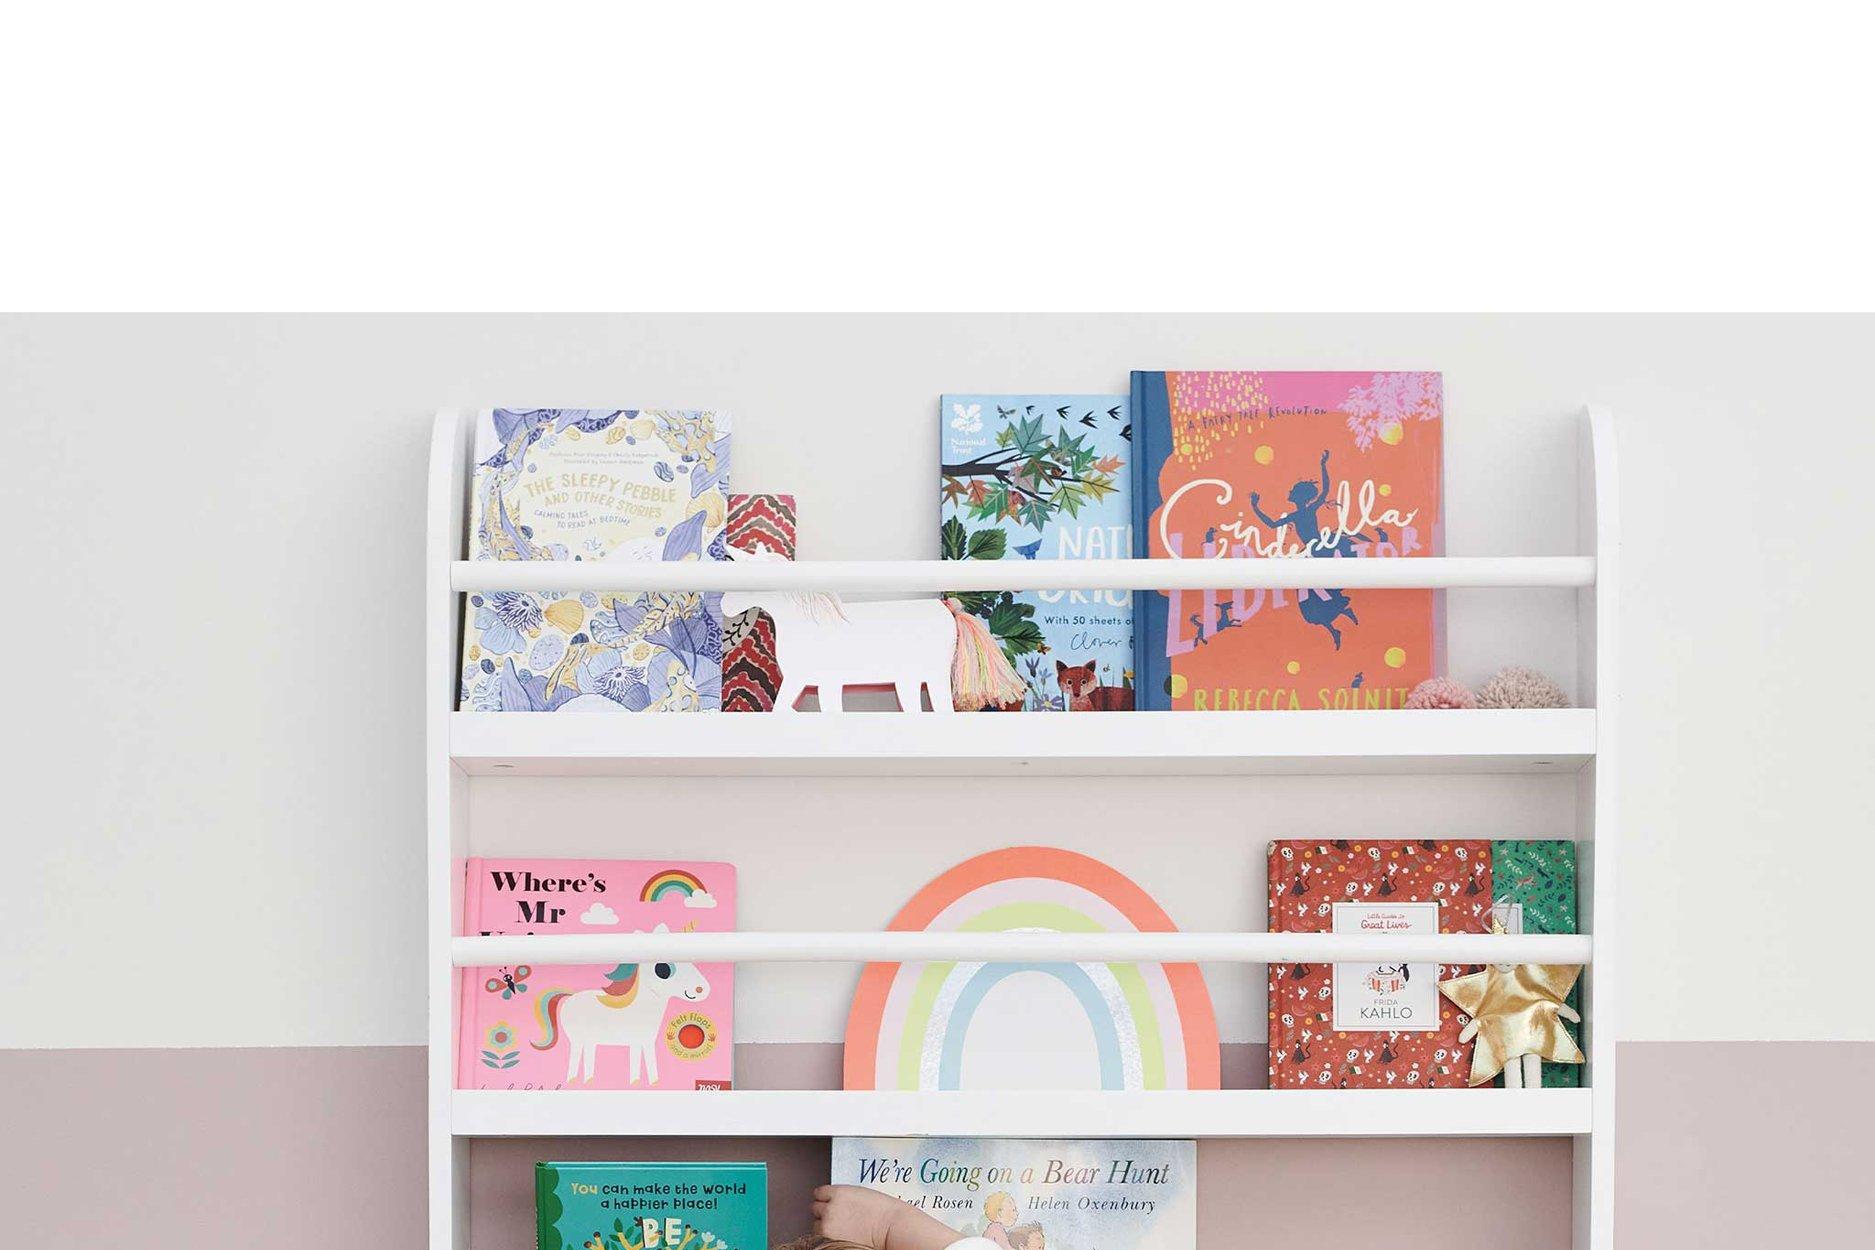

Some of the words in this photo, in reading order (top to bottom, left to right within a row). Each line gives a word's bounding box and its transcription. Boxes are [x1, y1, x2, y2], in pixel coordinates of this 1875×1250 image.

[523, 476, 555, 498] THE
[562, 473, 620, 492] SLEEPY
[623, 482, 678, 503] PEBBLE
[544, 491, 570, 507] AND
[574, 491, 615, 507] OTHER
[616, 499, 663, 519] STORIES
[534, 509, 566, 520] CALMING
[568, 510, 589, 519] TALES
[556, 521, 566, 529] TO
[567, 521, 586, 529] READ
[588, 518, 597, 526] AT
[600, 514, 631, 526] BEDTIME
[1044, 616, 1069, 625] With
[1072, 616, 1086, 625] 50
[1089, 616, 1122, 625] sheets
[1193, 688, 1301, 711] REBECCA
[490, 871, 606, 893] Where's
[515, 900, 566, 924] Mr
[1361, 920, 1385, 929] Great
[1386, 920, 1412, 929] Lives
[1374, 998, 1398, 1006] FRIDA
[1360, 1006, 1412, 1018] KAHLO
[858, 1158, 912, 1184] We're
[920, 1158, 982, 1192] Going
[988, 1167, 1012, 1184] on
[1020, 1167, 1033, 1184] a
[1042, 1160, 1100, 1184] Bear
[1107, 1160, 1170, 1184] Hunt
[571, 1182, 598, 1195] You
[602, 1184, 629, 1195] can
[633, 1182, 670, 1195] make
[675, 1182, 698, 1195] the
[703, 1182, 746, 1195] world
[600, 1200, 610, 1209] a
[614, 1198, 669, 1210] happier
[673, 1198, 718, 1210] place!
[932, 1196, 974, 1208] Rosen
[1028, 1196, 1070, 1210] Helen
[1078, 1197, 1155, 1215] Oxenbury
[641, 1217, 682, 1248] BE
